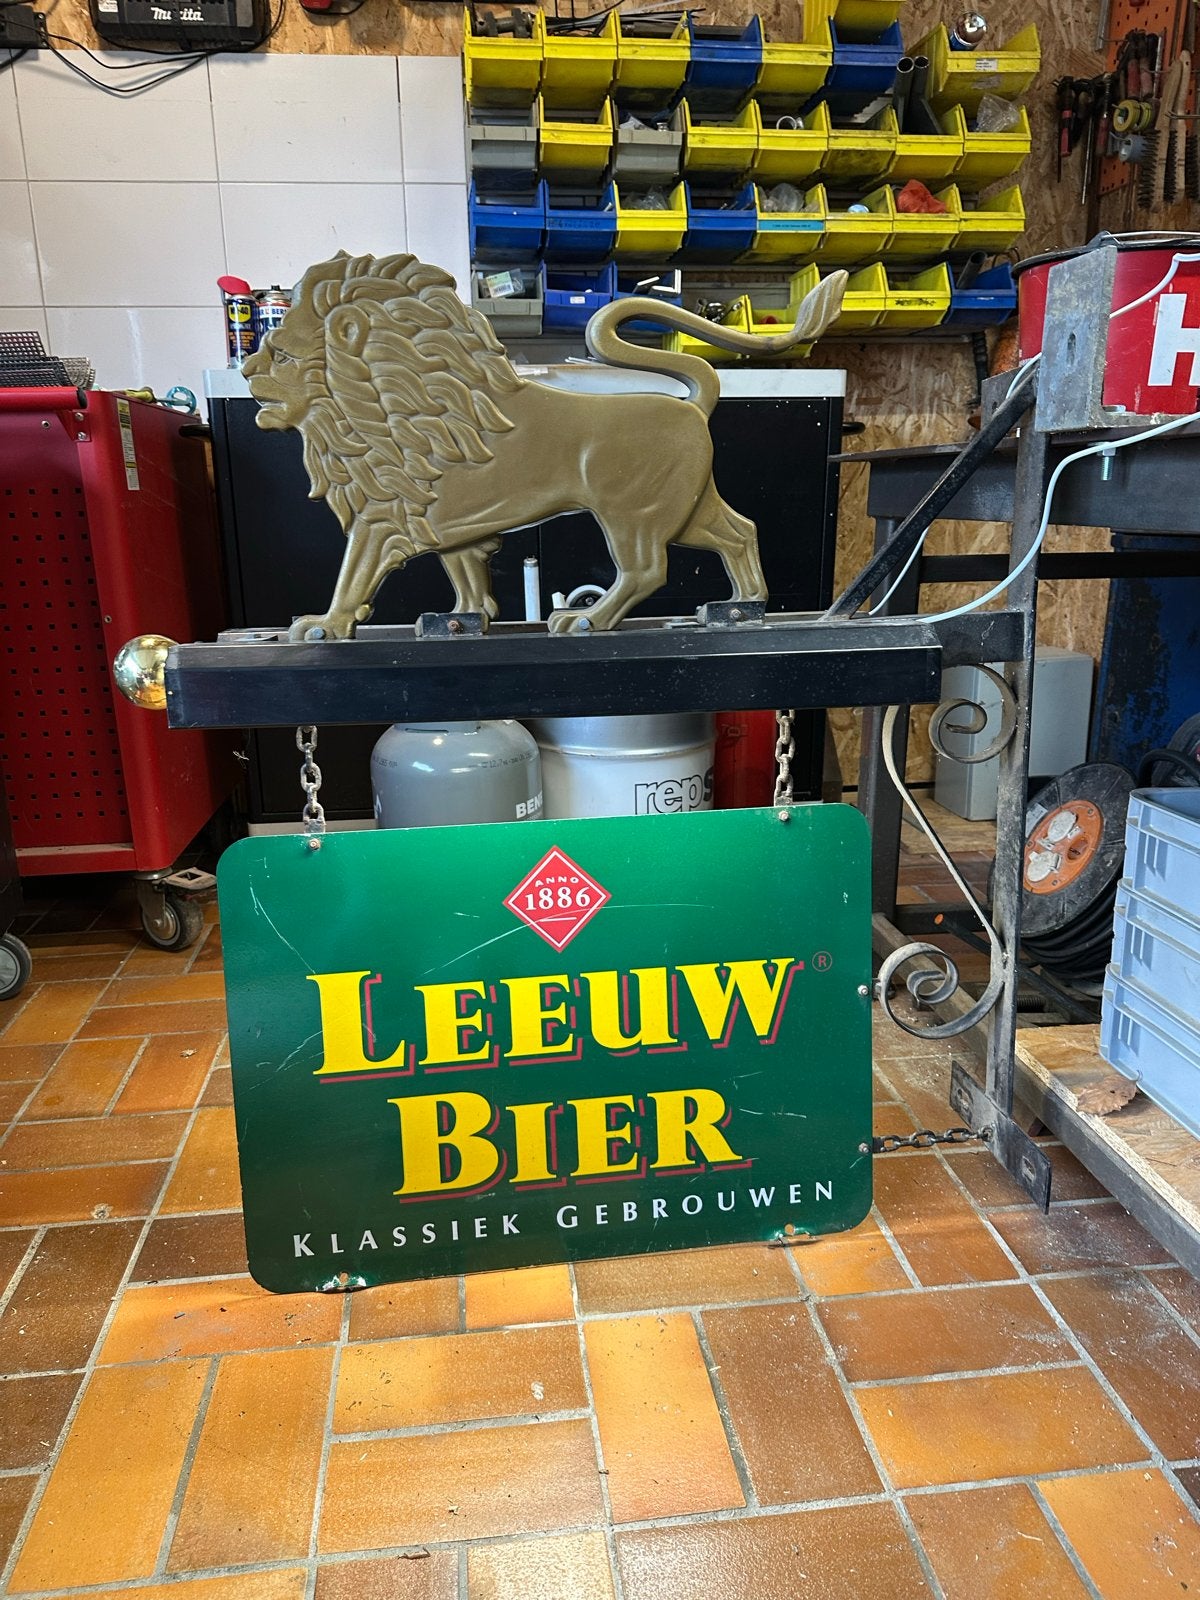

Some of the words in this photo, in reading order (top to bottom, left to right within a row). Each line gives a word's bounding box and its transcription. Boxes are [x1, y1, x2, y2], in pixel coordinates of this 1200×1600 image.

[525, 887, 590, 910] 1886
[535, 876, 579, 887] ANNO
[306, 957, 804, 1083] LEEUW
[387, 1088, 751, 1203] BIER
[293, 1213, 521, 1257] KLASSIEK
[555, 1180, 834, 1228] GEBROUWEN
